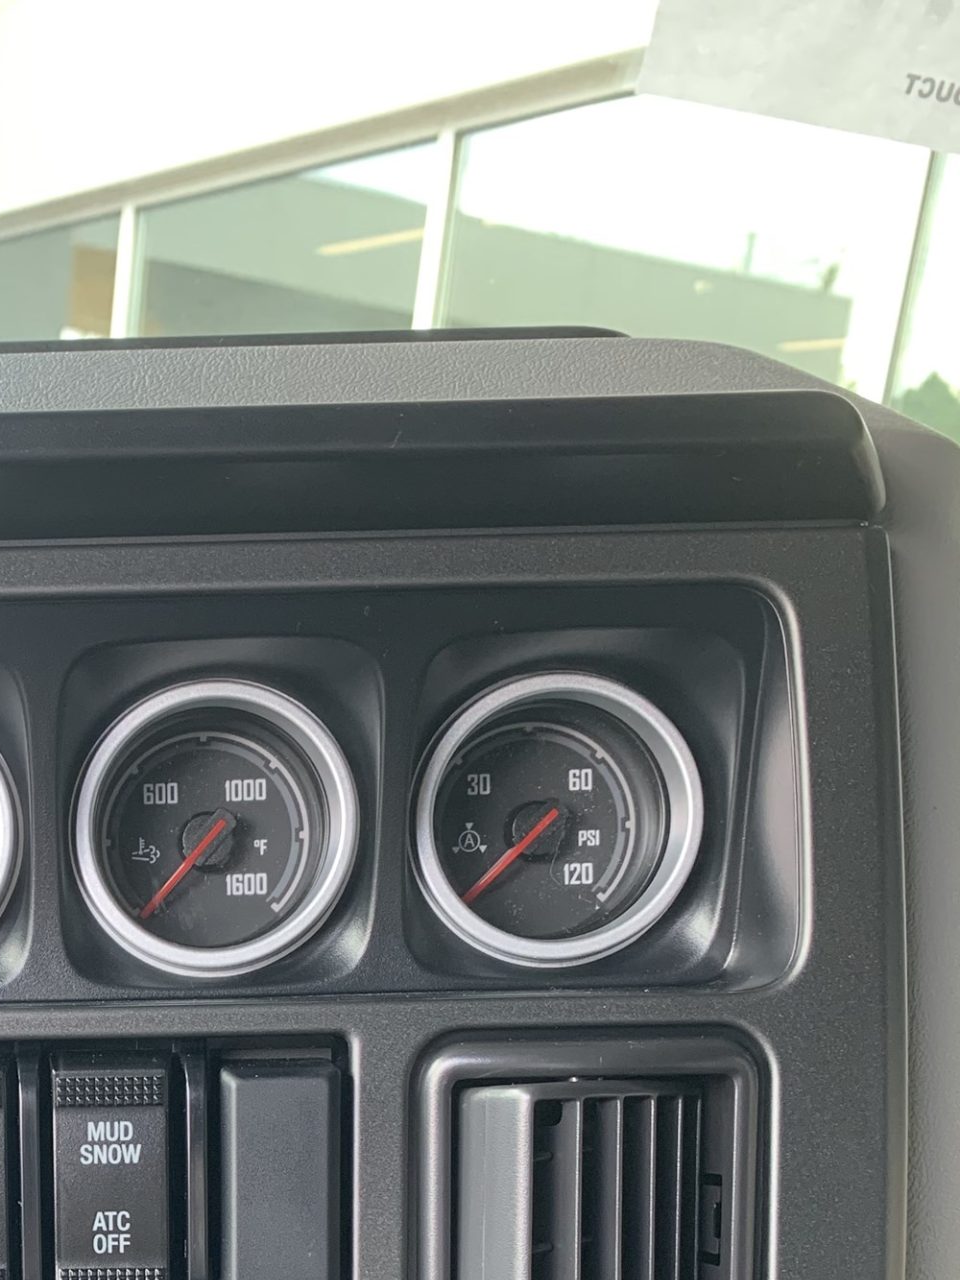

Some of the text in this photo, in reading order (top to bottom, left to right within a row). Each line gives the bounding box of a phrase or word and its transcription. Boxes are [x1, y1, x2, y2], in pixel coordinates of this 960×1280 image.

[225, 778, 267, 802] 1000
[466, 773, 491, 796] 30
[568, 768, 593, 791] 60
[142, 782, 179, 805] 600
[577, 829, 601, 847] PSI
[225, 872, 268, 896] 1600
[562, 862, 594, 885] 120
[86, 1120, 134, 1142] MUD
[79, 1143, 142, 1165] SNOW
[91, 1210, 131, 1232] ATC
[92, 1233, 131, 1255] OFF
